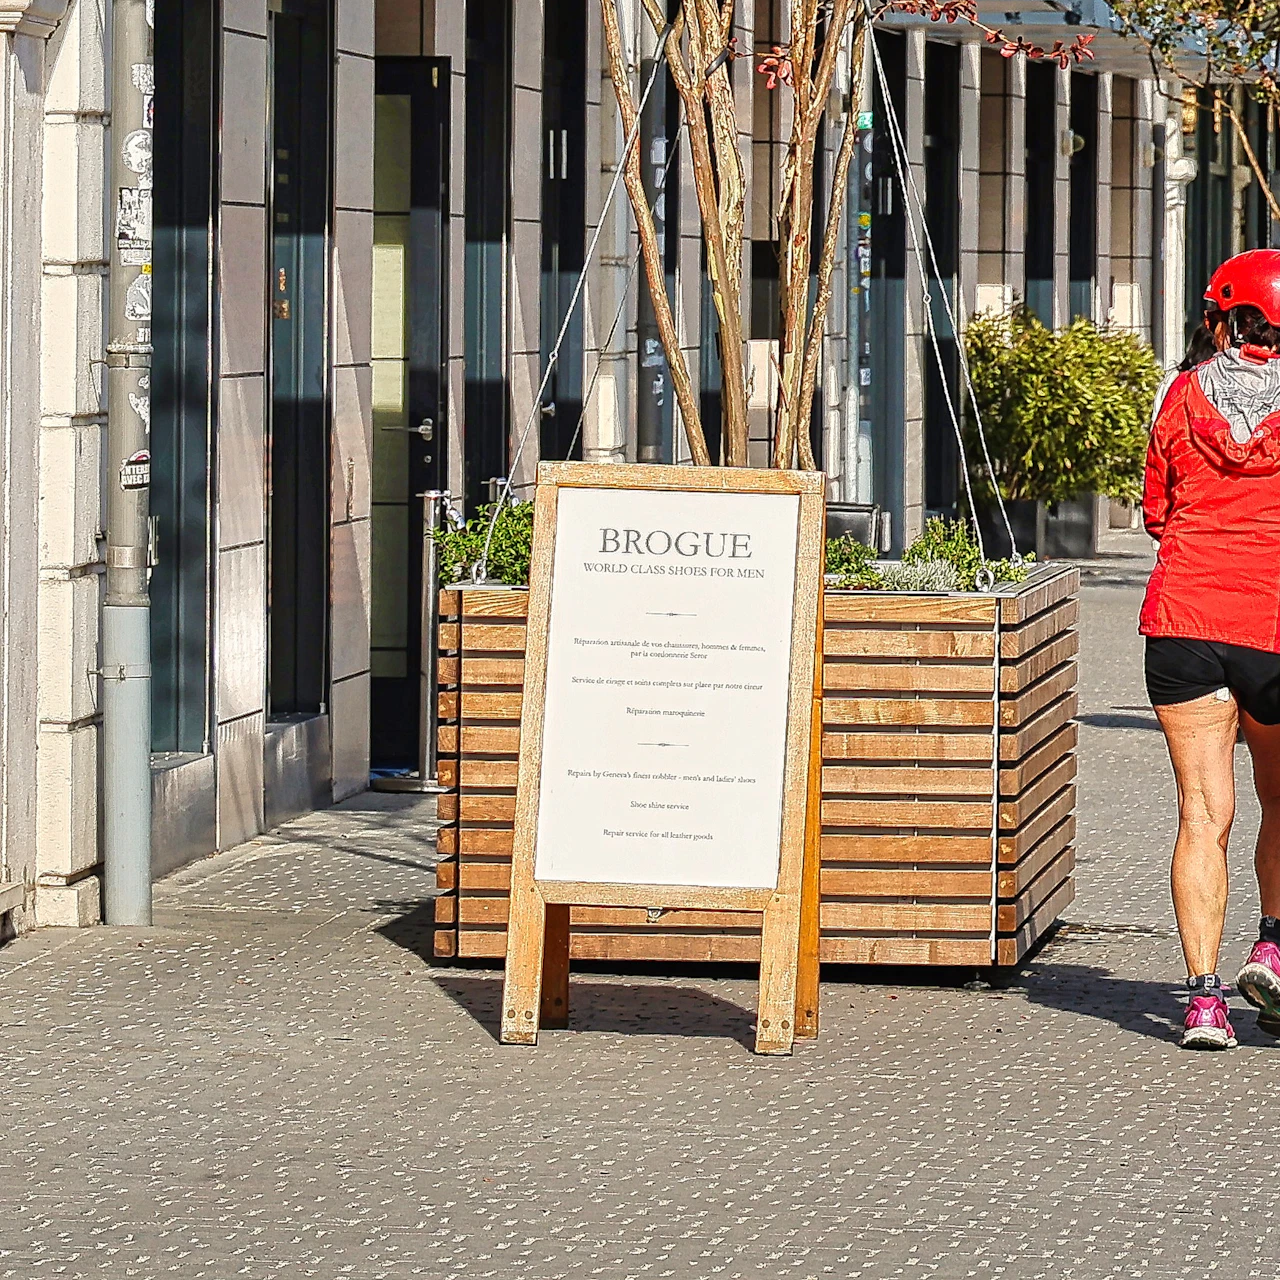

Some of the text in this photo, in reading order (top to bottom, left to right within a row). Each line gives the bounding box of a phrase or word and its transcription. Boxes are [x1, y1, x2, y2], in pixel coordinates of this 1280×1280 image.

[598, 528, 753, 558] BROGUE
[583, 562, 765, 578] WORLD CLASS SHOES FOR MEN
[701, 642, 729, 650] hommes
[630, 651, 642, 659] par
[571, 676, 595, 684] Service
[567, 769, 592, 779] Repairs
[630, 800, 647, 809] Shoe
[648, 801, 665, 809] shine
[603, 829, 624, 838] Repair
[625, 830, 648, 838] service
[650, 830, 660, 838] for
[670, 831, 693, 839] leather
[693, 833, 713, 841] goods
